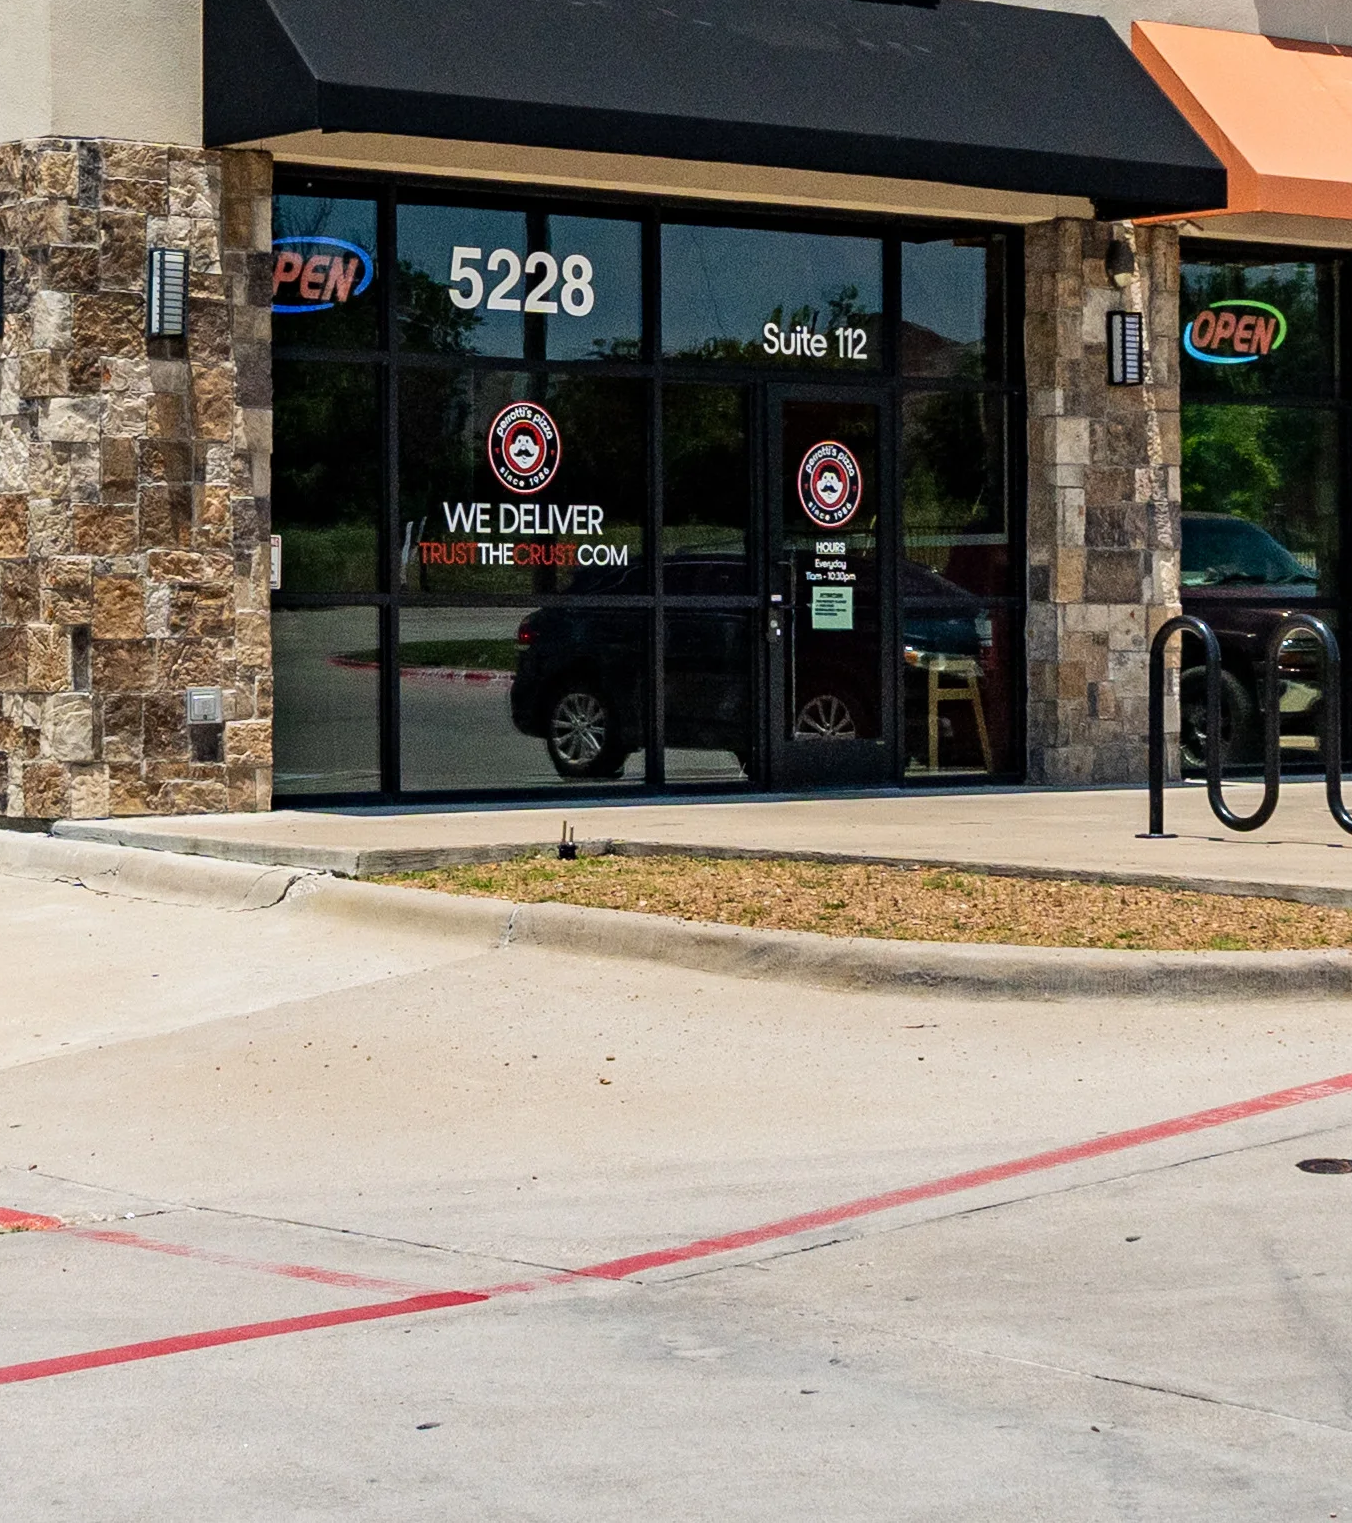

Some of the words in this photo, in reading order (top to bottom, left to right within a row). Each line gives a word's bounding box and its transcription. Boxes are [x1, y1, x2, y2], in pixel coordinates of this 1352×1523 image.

[272, 251, 359, 302] PEN
[448, 246, 595, 317] 5228
[762, 322, 828, 359] Suite
[835, 327, 868, 360] 112
[1190, 310, 1276, 356] OPEN
[533, 413, 554, 440] pizza
[499, 466, 525, 487] since
[529, 466, 550, 486] 1986
[443, 502, 491, 533] WE
[499, 503, 603, 535] DELIVER
[814, 558, 847, 570] Everyday
[816, 542, 846, 554] HOURS
